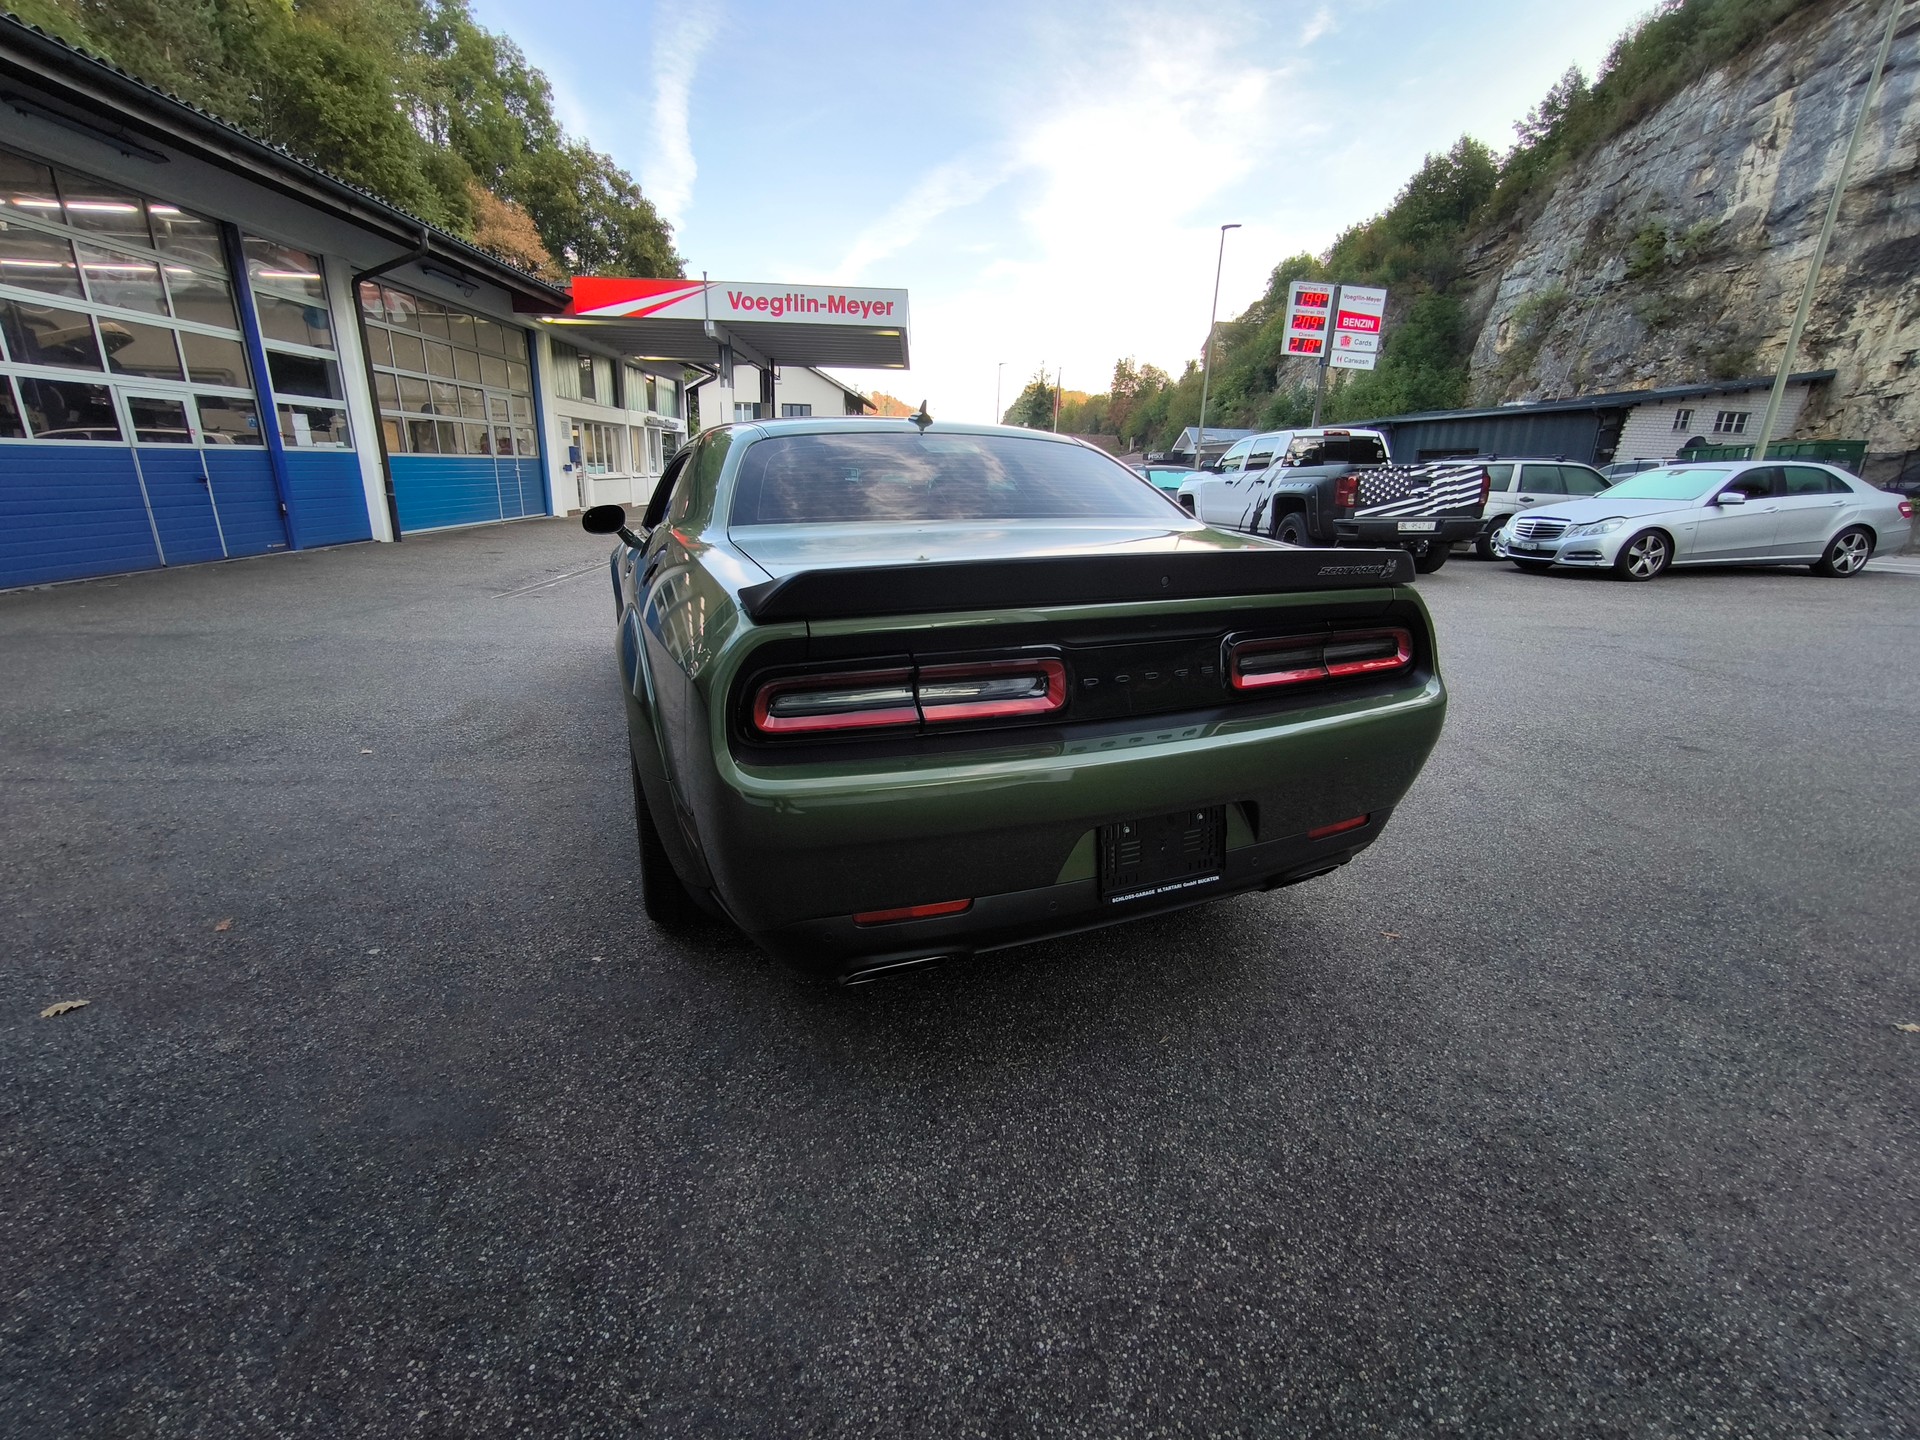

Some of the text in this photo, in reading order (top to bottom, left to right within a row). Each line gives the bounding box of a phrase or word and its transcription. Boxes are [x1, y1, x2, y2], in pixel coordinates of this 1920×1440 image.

[1343, 293, 1382, 304] Voegtlin-Meyer
[727, 291, 894, 319] Voegtlin-Meyer
[1342, 317, 1375, 329] BENZIN
[1354, 338, 1372, 346] Cards
[1343, 356, 1370, 365] Carwash
[1083, 665, 1214, 687] DODGE
[1112, 889, 1155, 903] SCHLOSS-GARAGE
[1182, 880, 1197, 888] GmbH
[1197, 875, 1220, 884] BUCKTEN
